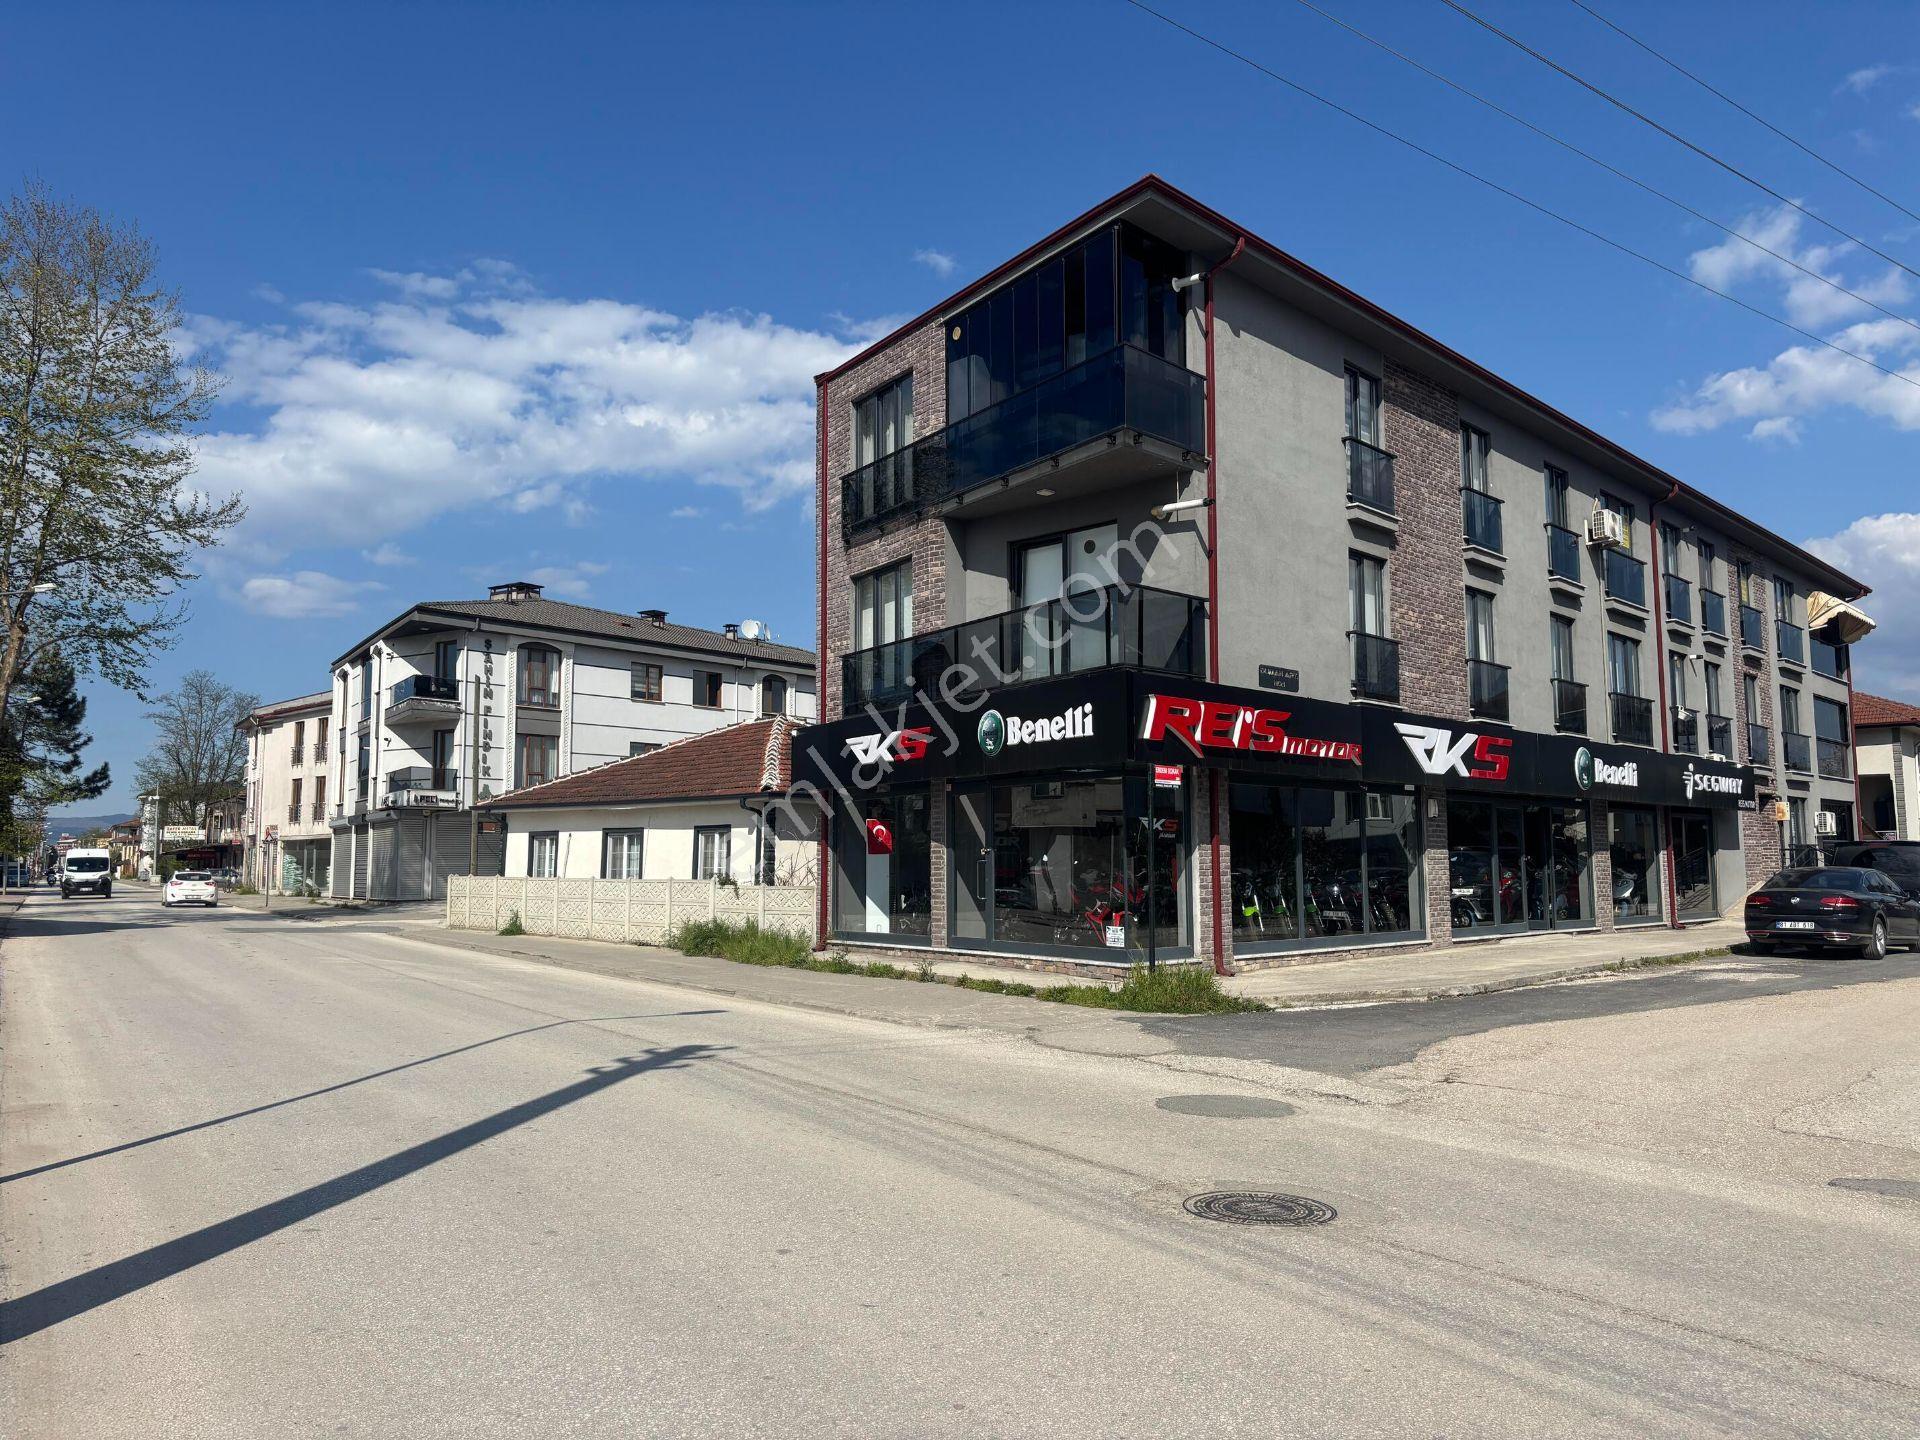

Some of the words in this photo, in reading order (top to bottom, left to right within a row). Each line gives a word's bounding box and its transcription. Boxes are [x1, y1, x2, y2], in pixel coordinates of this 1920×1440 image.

[1006, 702, 1094, 746] Benelli
[845, 726, 933, 765] RKS
[1393, 722, 1513, 781] RKS
[1594, 757, 1639, 787] Benelli
[1694, 773, 1743, 795] SEGWAY
